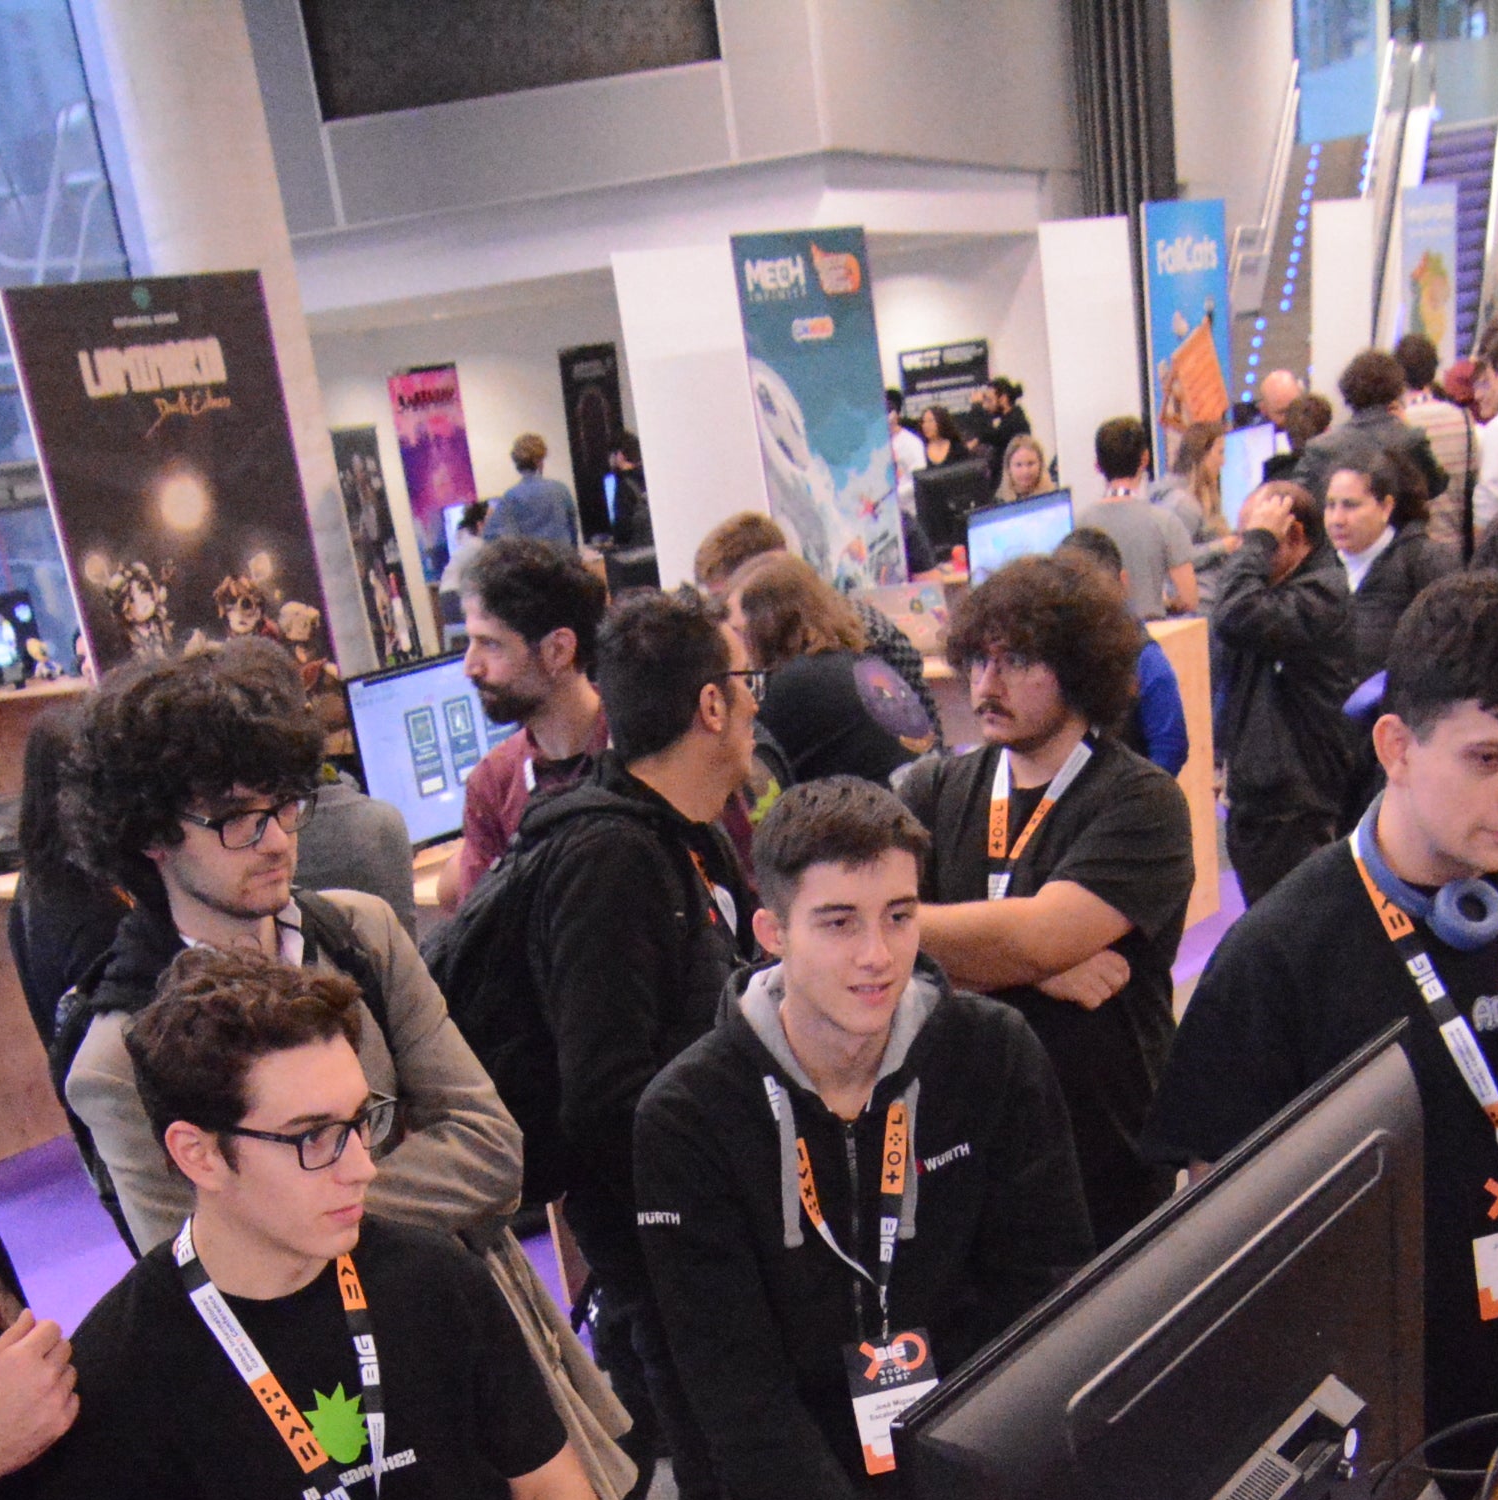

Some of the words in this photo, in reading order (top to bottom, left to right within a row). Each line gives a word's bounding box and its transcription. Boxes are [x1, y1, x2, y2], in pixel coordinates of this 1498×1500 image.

[744, 254, 805, 292] MECH
[1406, 952, 1446, 1003] BIG
[880, 1217, 898, 1262] BIG
[353, 1334, 381, 1386] BIG
[873, 1342, 906, 1362] BIG
